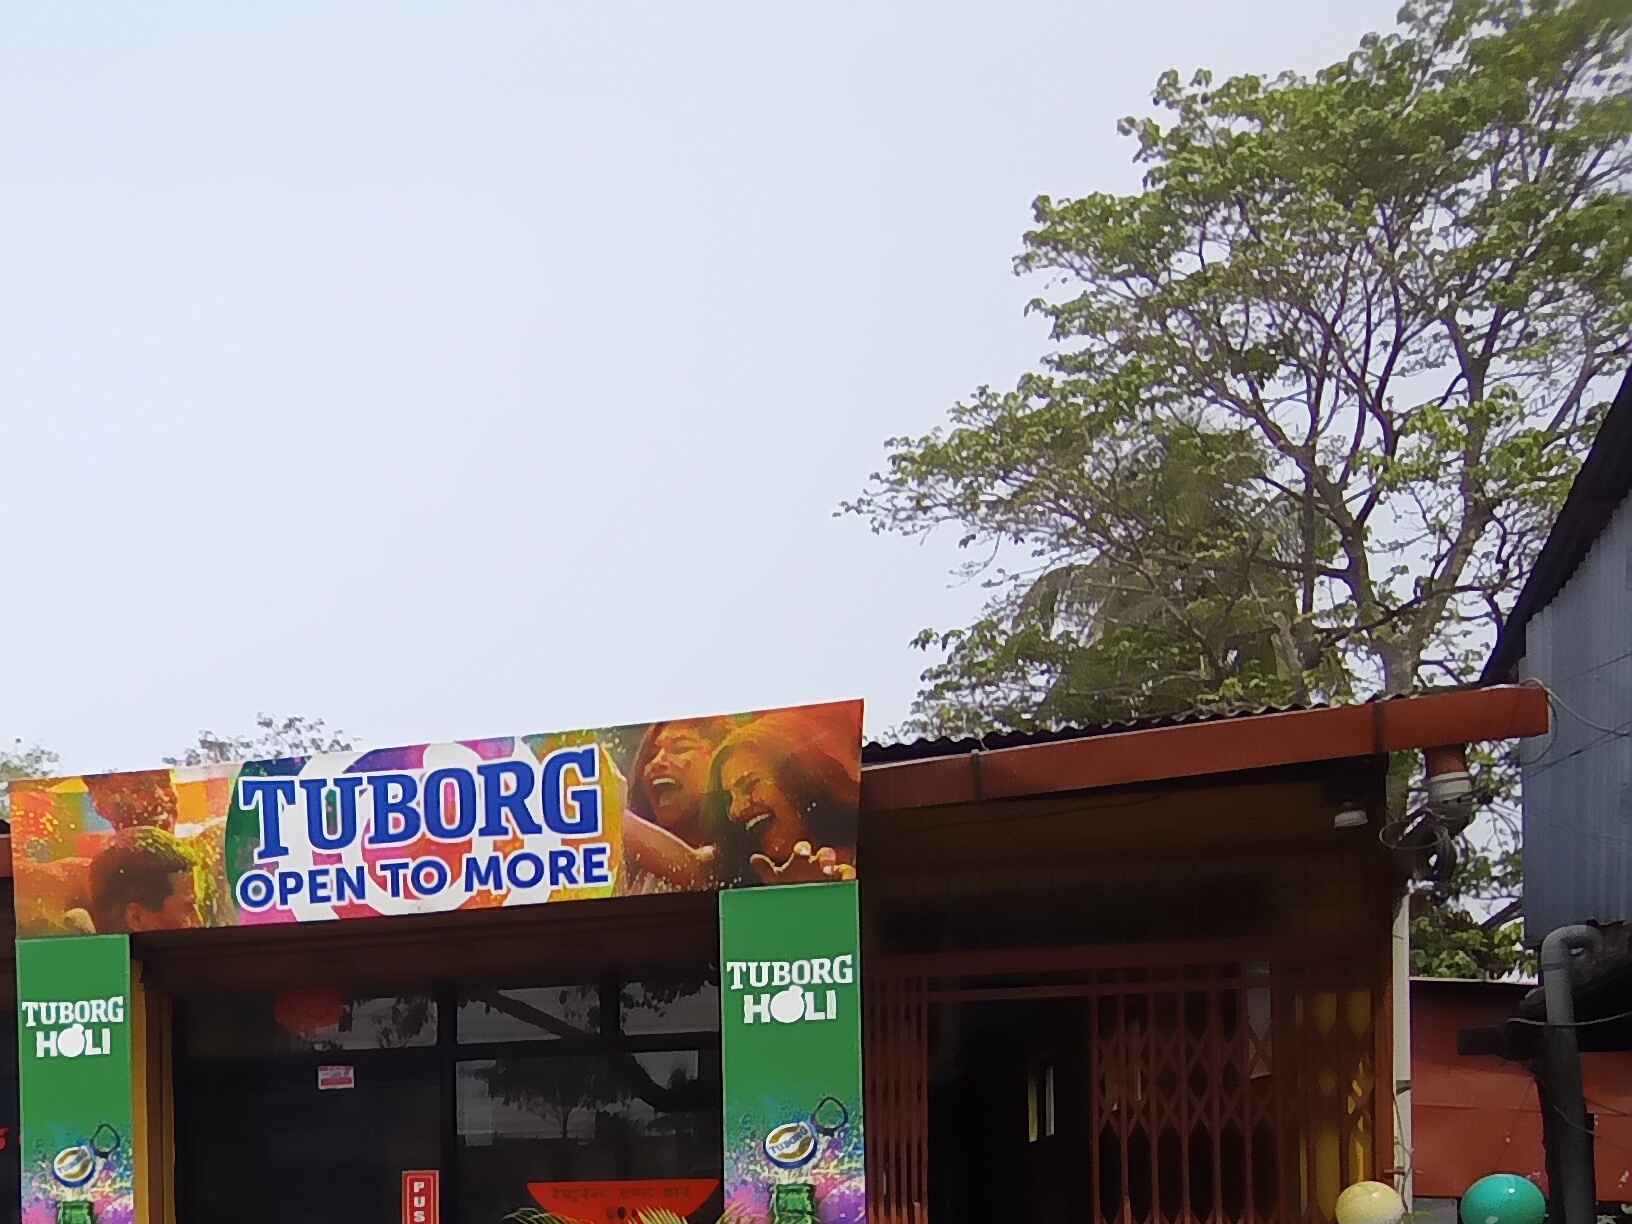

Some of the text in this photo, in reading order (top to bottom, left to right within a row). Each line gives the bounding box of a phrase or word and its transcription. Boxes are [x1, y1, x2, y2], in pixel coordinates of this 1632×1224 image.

[242, 747, 601, 861] TUBORG
[239, 846, 610, 909] OPEN TO MORE
[726, 954, 854, 990] TUBORG
[22, 995, 125, 1028] TUBORG
[743, 984, 838, 1024] HOLI
[36, 1022, 111, 1058] HOLI
